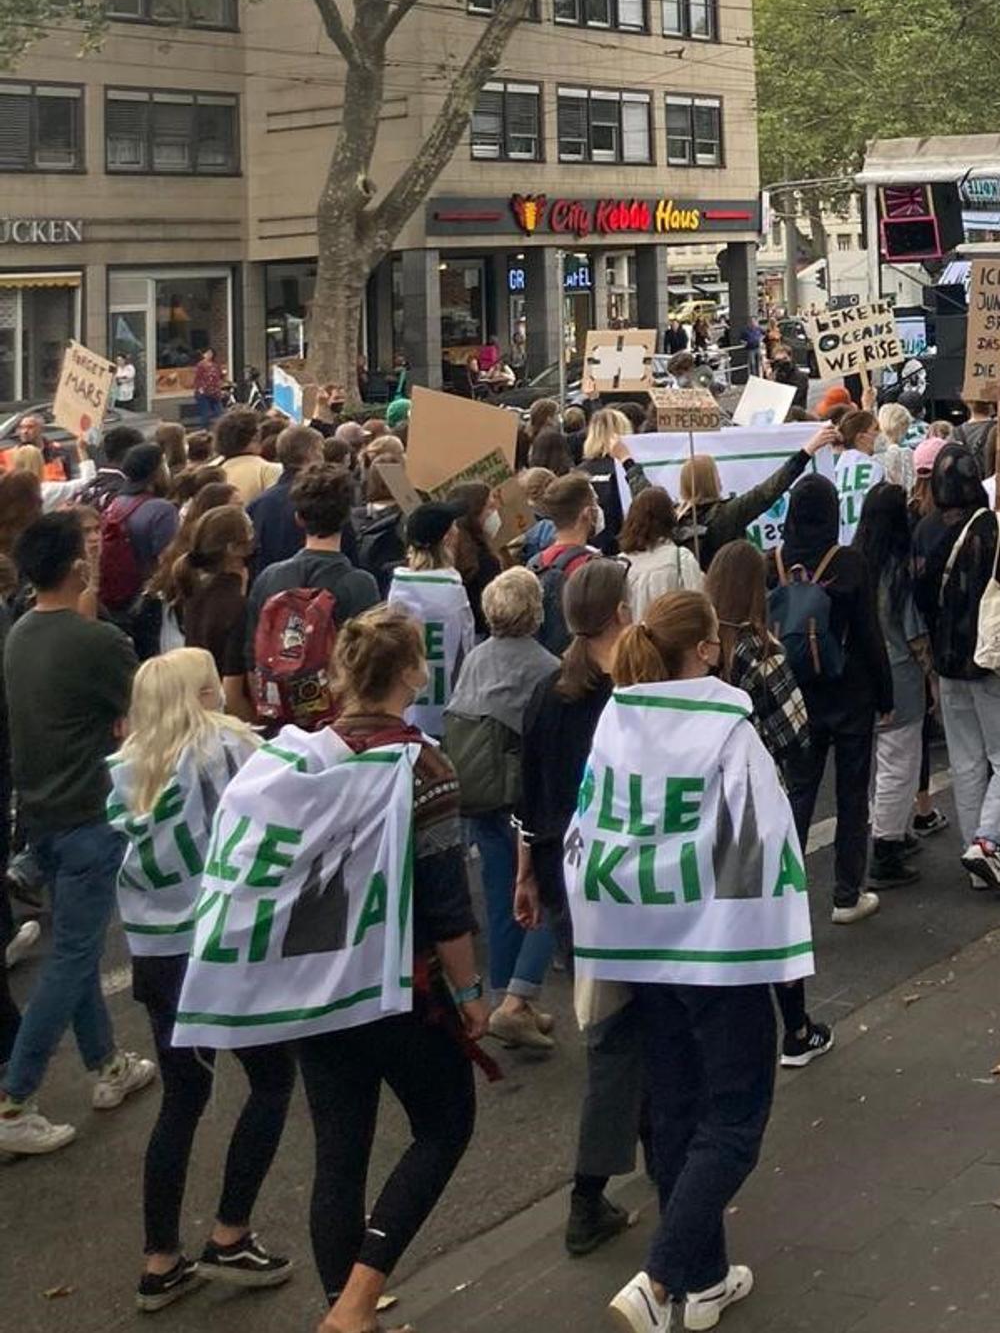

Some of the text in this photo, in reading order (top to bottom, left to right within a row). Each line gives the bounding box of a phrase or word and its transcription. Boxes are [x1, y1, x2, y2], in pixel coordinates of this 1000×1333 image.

[551, 198, 590, 237] City
[656, 199, 700, 232] Haus
[824, 350, 858, 371] WE
[971, 361, 997, 378] DIE
[674, 413, 720, 428] PERIOD
